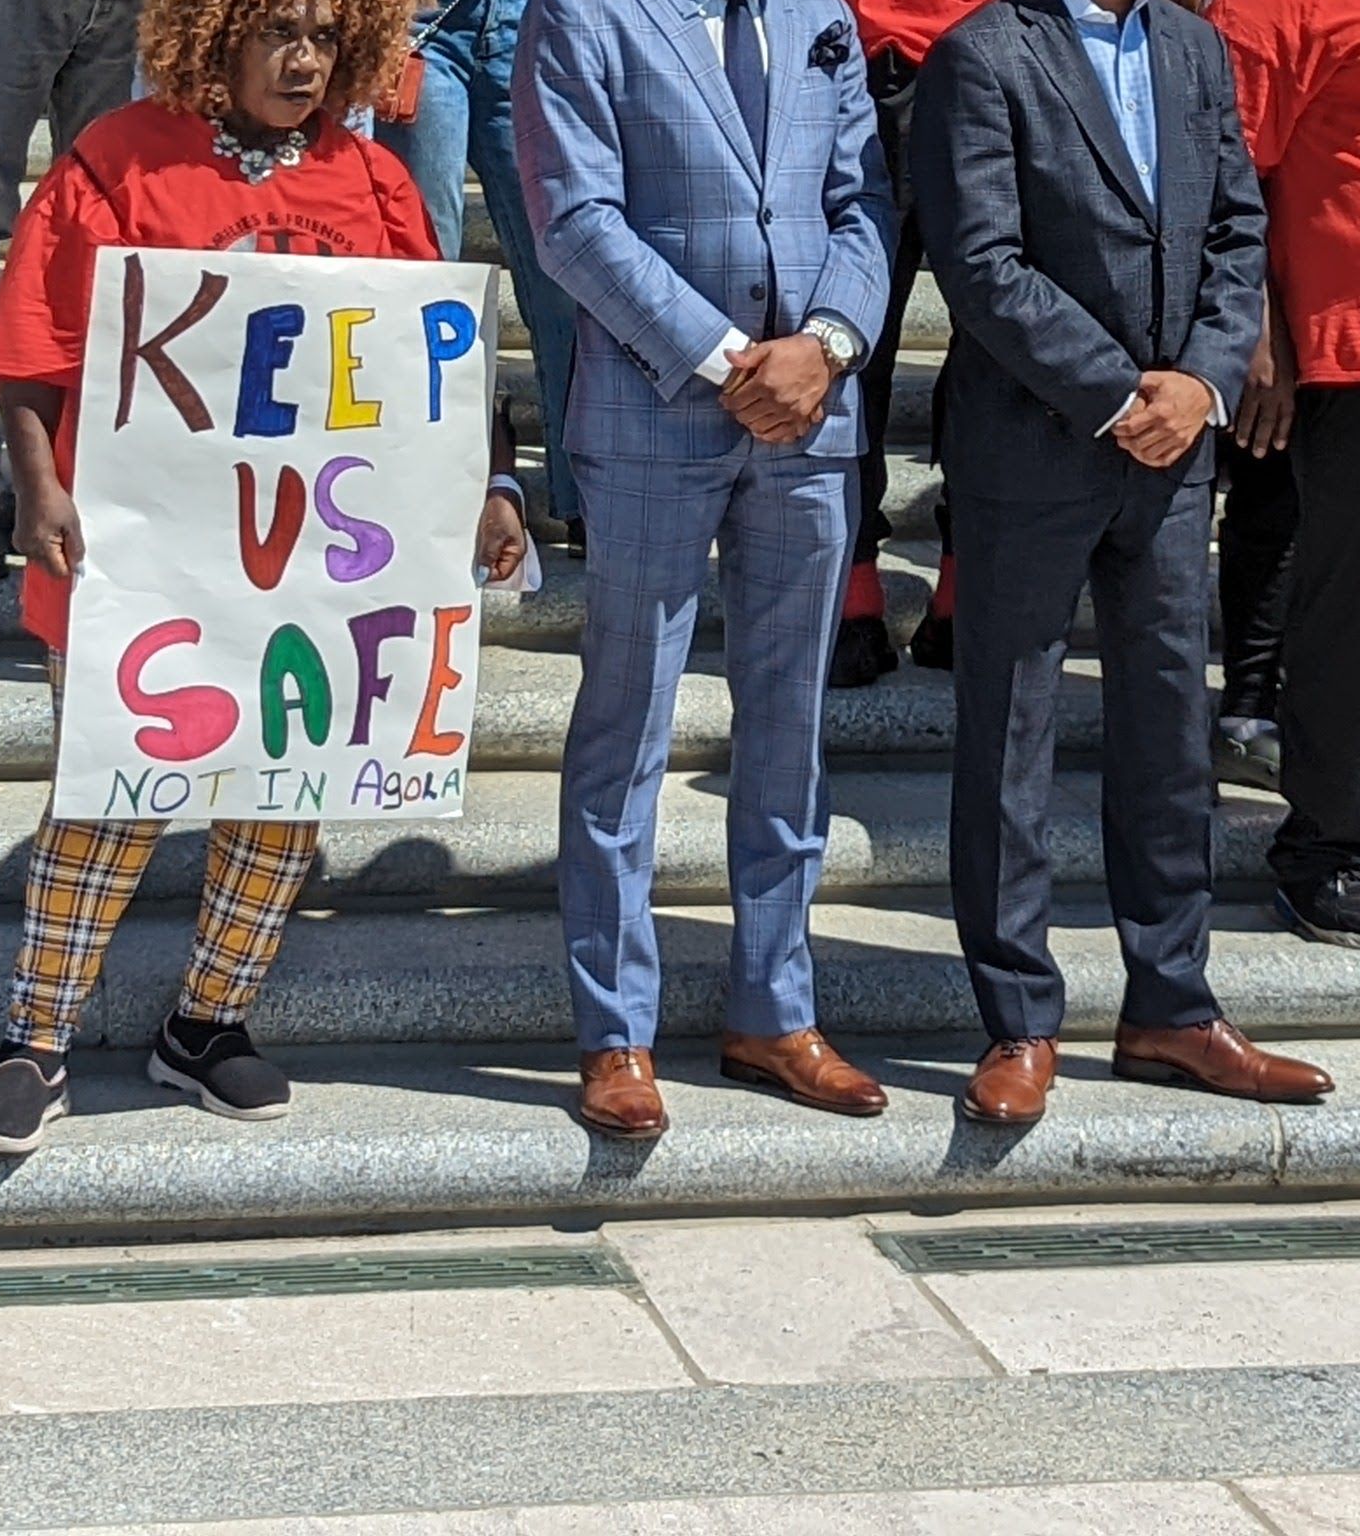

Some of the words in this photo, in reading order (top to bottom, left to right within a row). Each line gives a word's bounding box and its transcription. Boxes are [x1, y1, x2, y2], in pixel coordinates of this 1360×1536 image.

[286, 213, 356, 253] FRIENDS
[114, 252, 477, 437] KEEP
[231, 454, 395, 592] US
[117, 604, 472, 761] SAFE
[104, 767, 236, 816] NOT
[256, 766, 328, 813] IN
